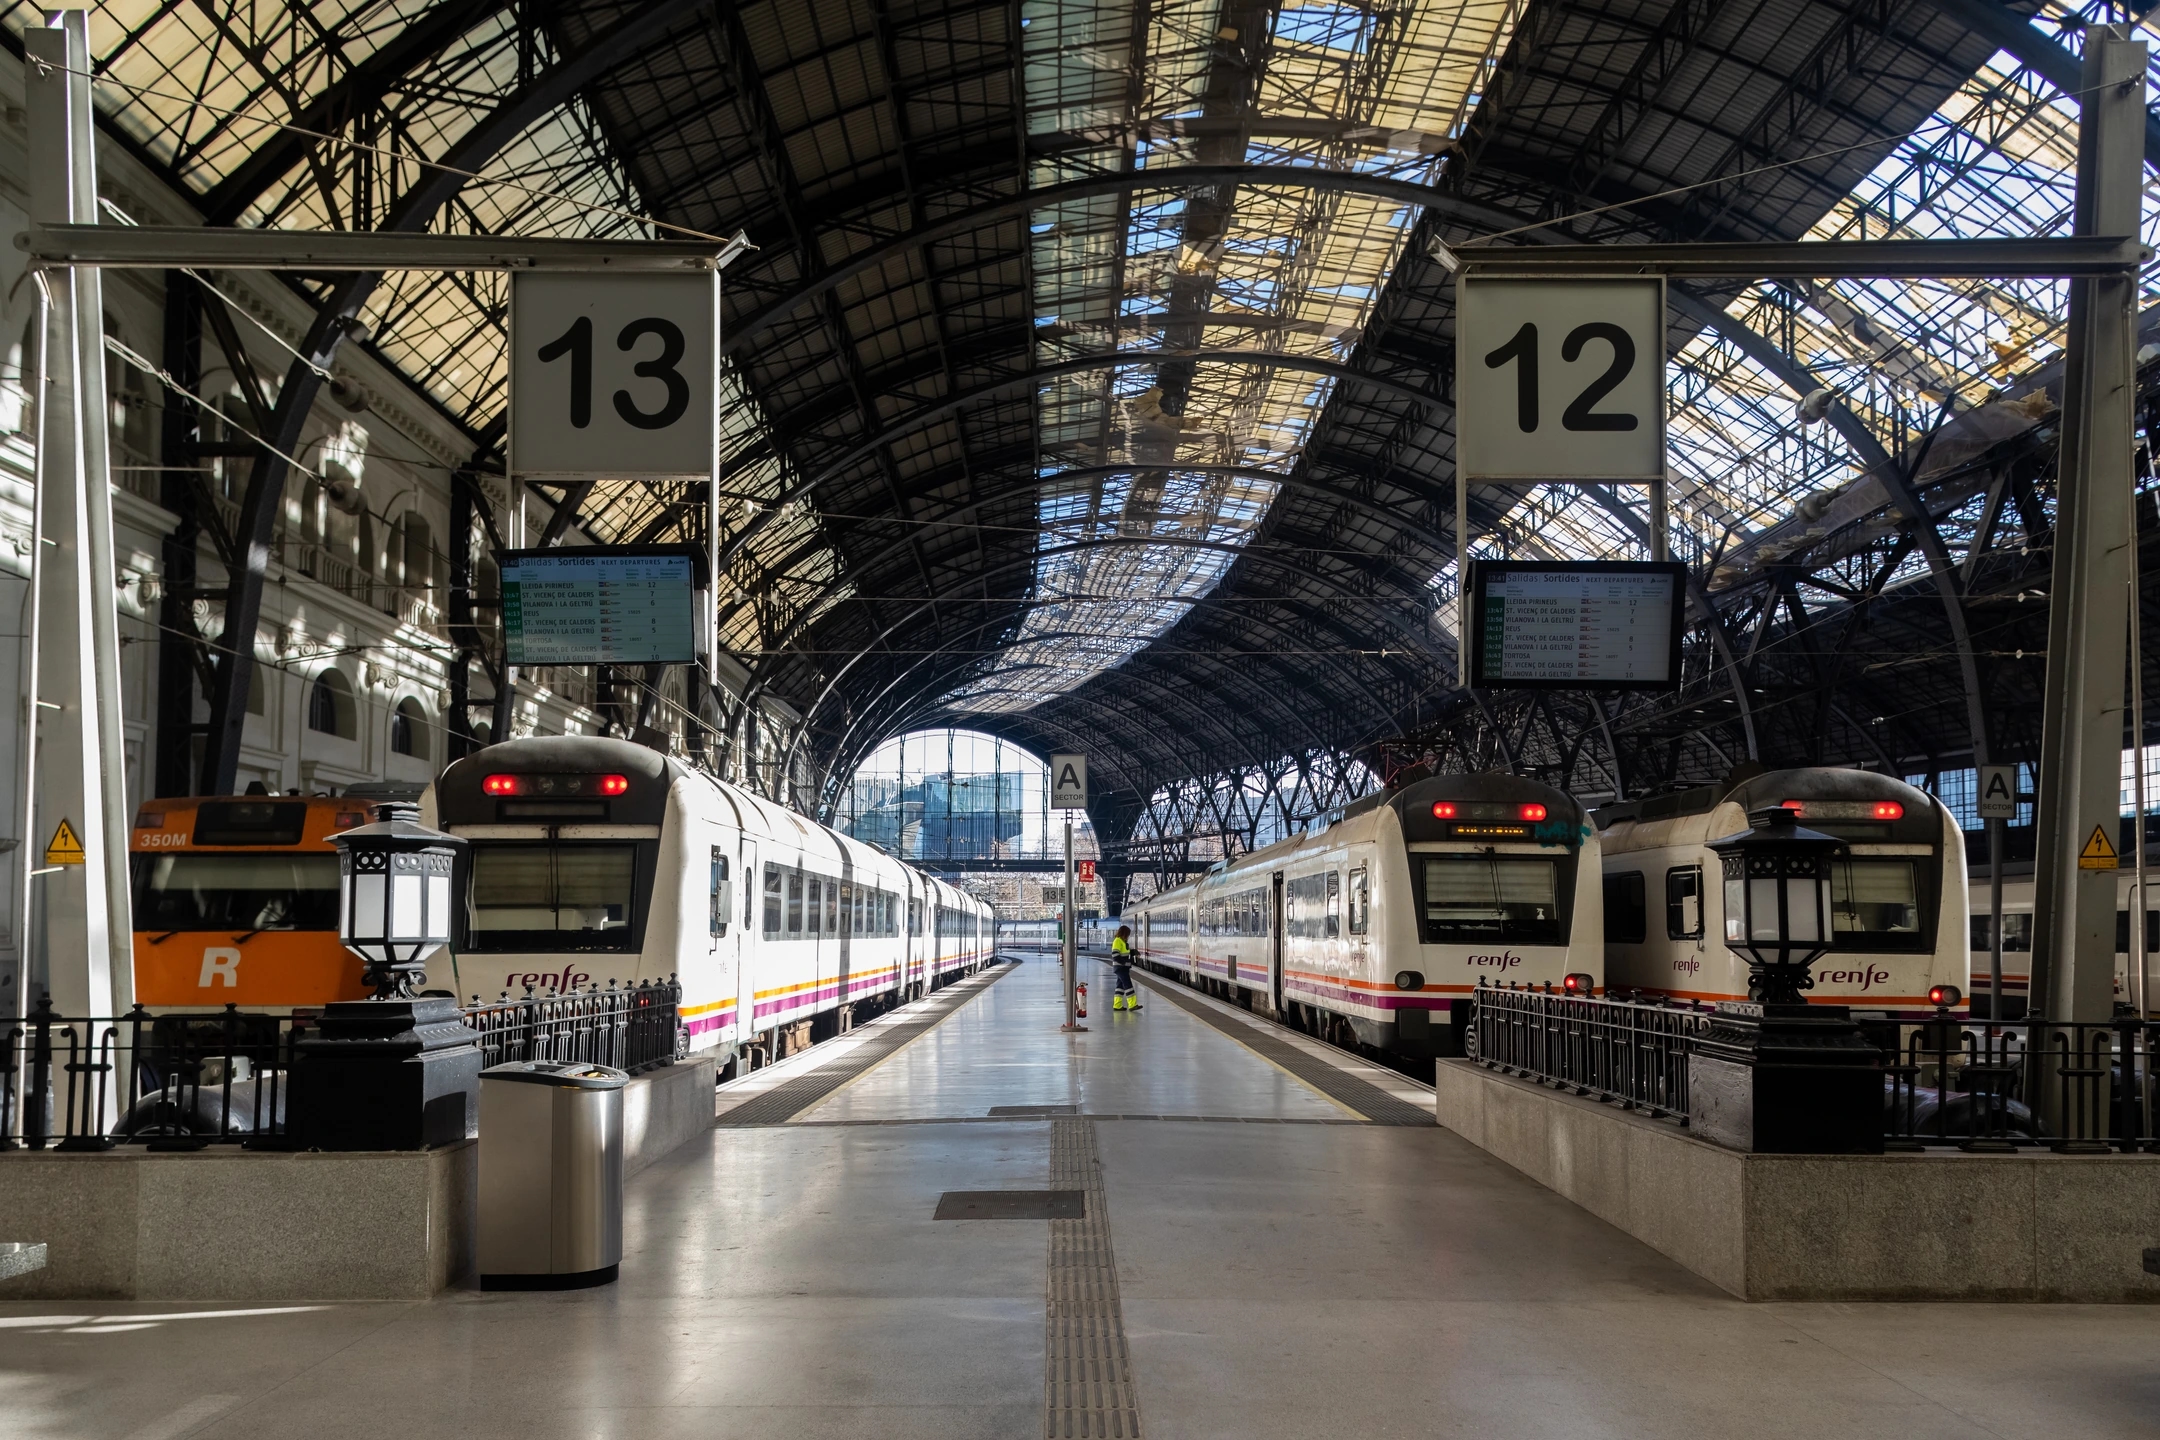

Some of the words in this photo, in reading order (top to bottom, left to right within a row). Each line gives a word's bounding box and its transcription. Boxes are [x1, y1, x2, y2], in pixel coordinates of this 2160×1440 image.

[538, 316, 690, 430] 13
[1484, 322, 1639, 433] 12
[520, 557, 552, 567] Salidas
[558, 557, 595, 566] Sortides
[1507, 573, 1538, 582] Salidas
[1544, 574, 1580, 582] Sortides
[534, 592, 555, 600] VICENÇ
[535, 619, 557, 627] VICENÇ
[1057, 763, 1081, 790] A
[1985, 772, 2010, 800] A
[1982, 803, 2013, 811] SECTOR
[140, 832, 187, 847] 350M
[1044, 890, 1057, 900] 13
[198, 947, 241, 987] R
[1467, 950, 1521, 972] renfe
[1673, 954, 1700, 978] renfe
[506, 963, 590, 996] renfe
[1819, 963, 1889, 991] renfe
